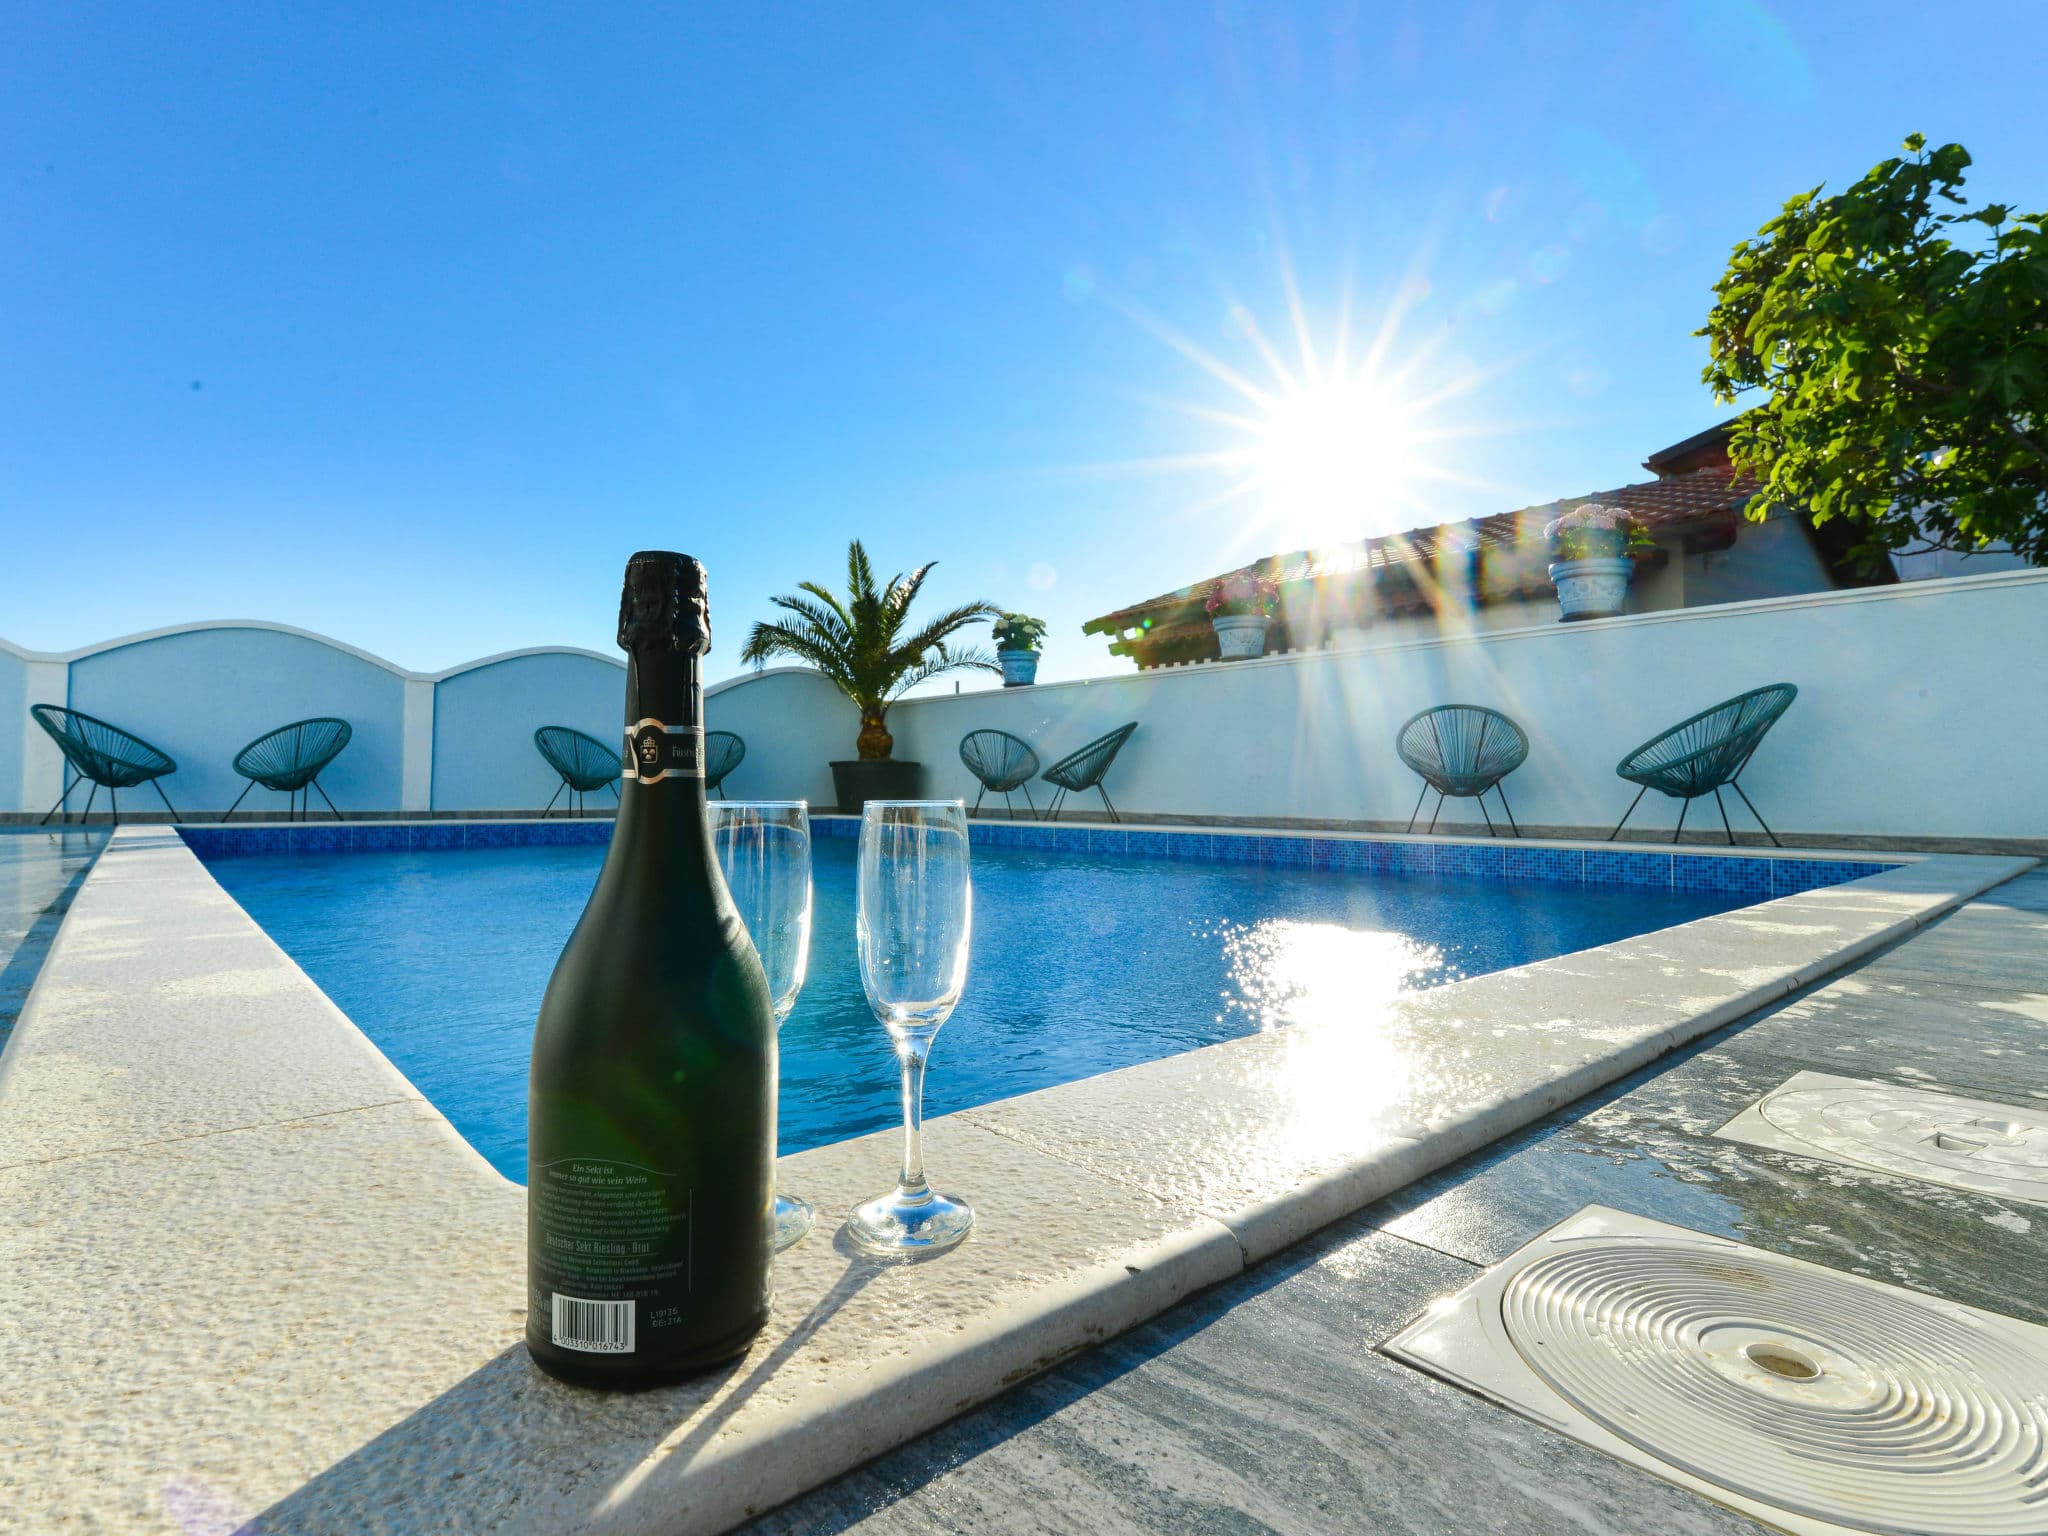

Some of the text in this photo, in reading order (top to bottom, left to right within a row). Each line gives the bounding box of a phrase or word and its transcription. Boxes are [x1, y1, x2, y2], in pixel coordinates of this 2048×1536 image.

[572, 1163, 613, 1175] Ein Sekt ist
[569, 1174, 577, 1182] so
[577, 1175, 590, 1185] gut
[591, 1175, 606, 1185] wie
[607, 1176, 624, 1185] sein
[625, 1175, 647, 1184] Wein
[576, 1240, 592, 1252] Sekt
[593, 1241, 626, 1256] Riesling
[631, 1241, 650, 1253] Brut
